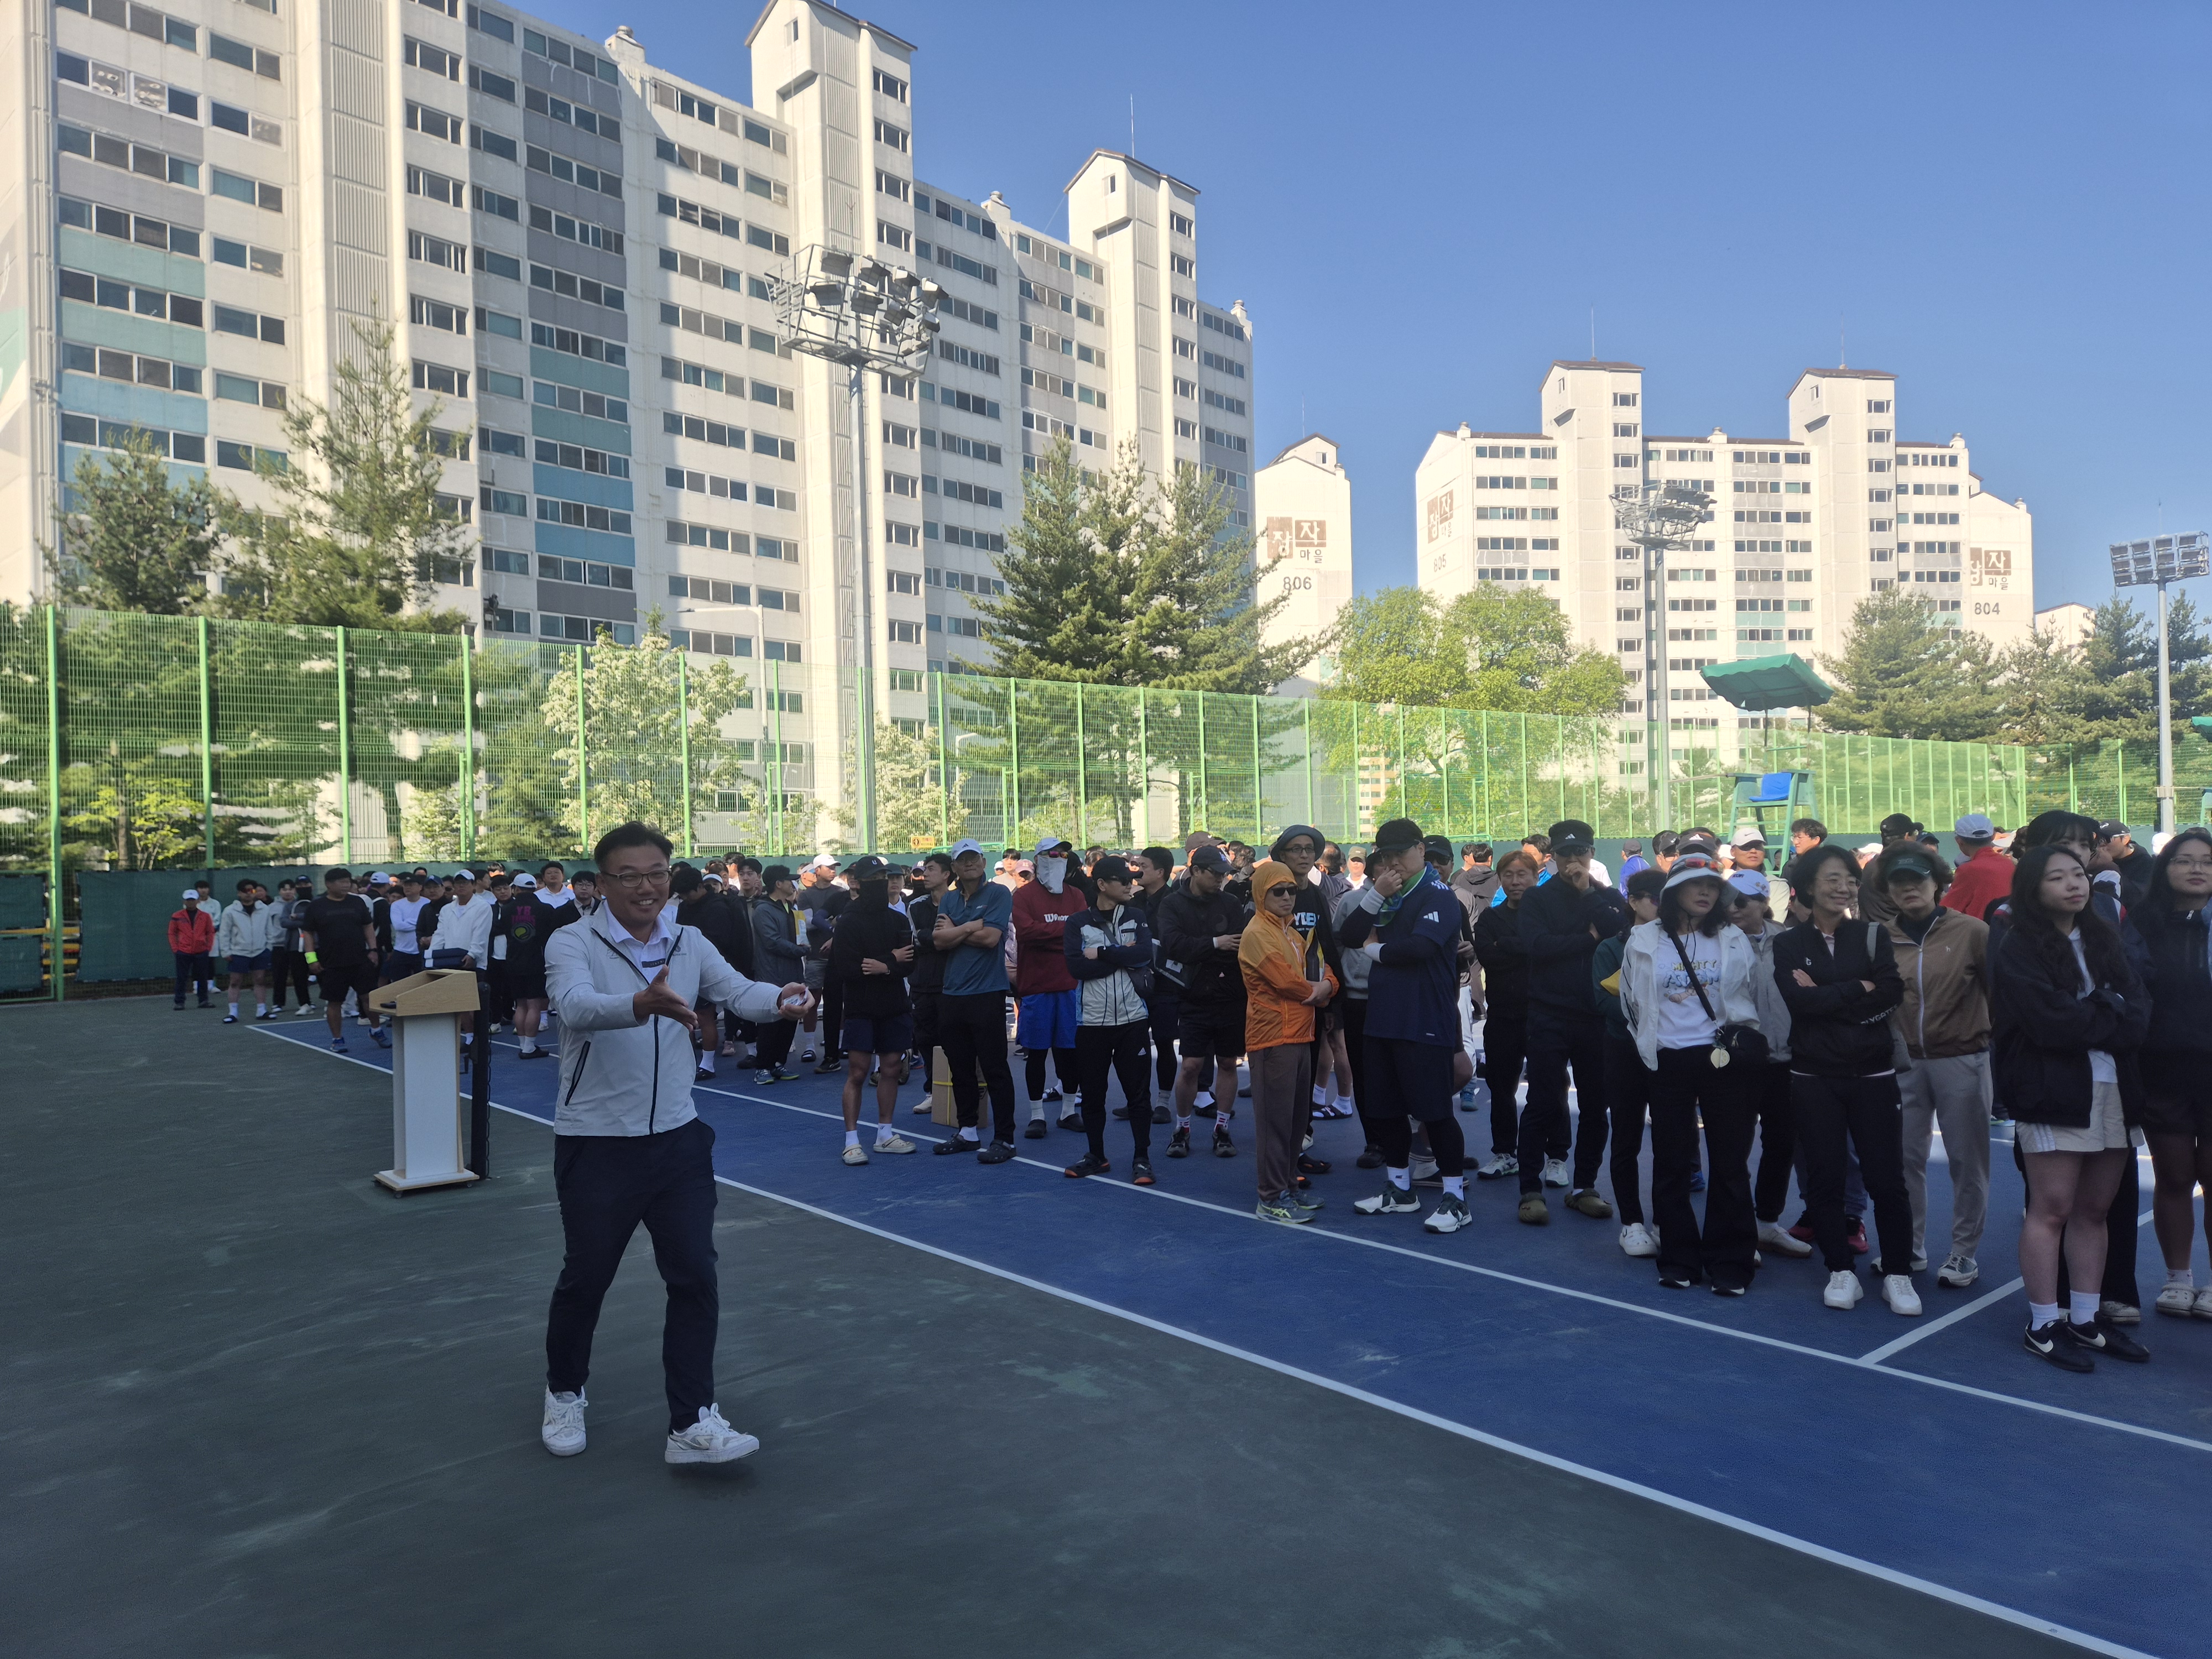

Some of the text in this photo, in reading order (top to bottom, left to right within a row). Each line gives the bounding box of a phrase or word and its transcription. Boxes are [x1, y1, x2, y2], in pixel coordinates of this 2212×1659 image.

[1300, 549, 1323, 564] 마을
[1433, 554, 1447, 573] 805
[1283, 576, 1312, 590] 806
[1989, 577, 2009, 591] 마을
[1974, 602, 2001, 615] 804
[1671, 959, 1717, 971] MIHTY
